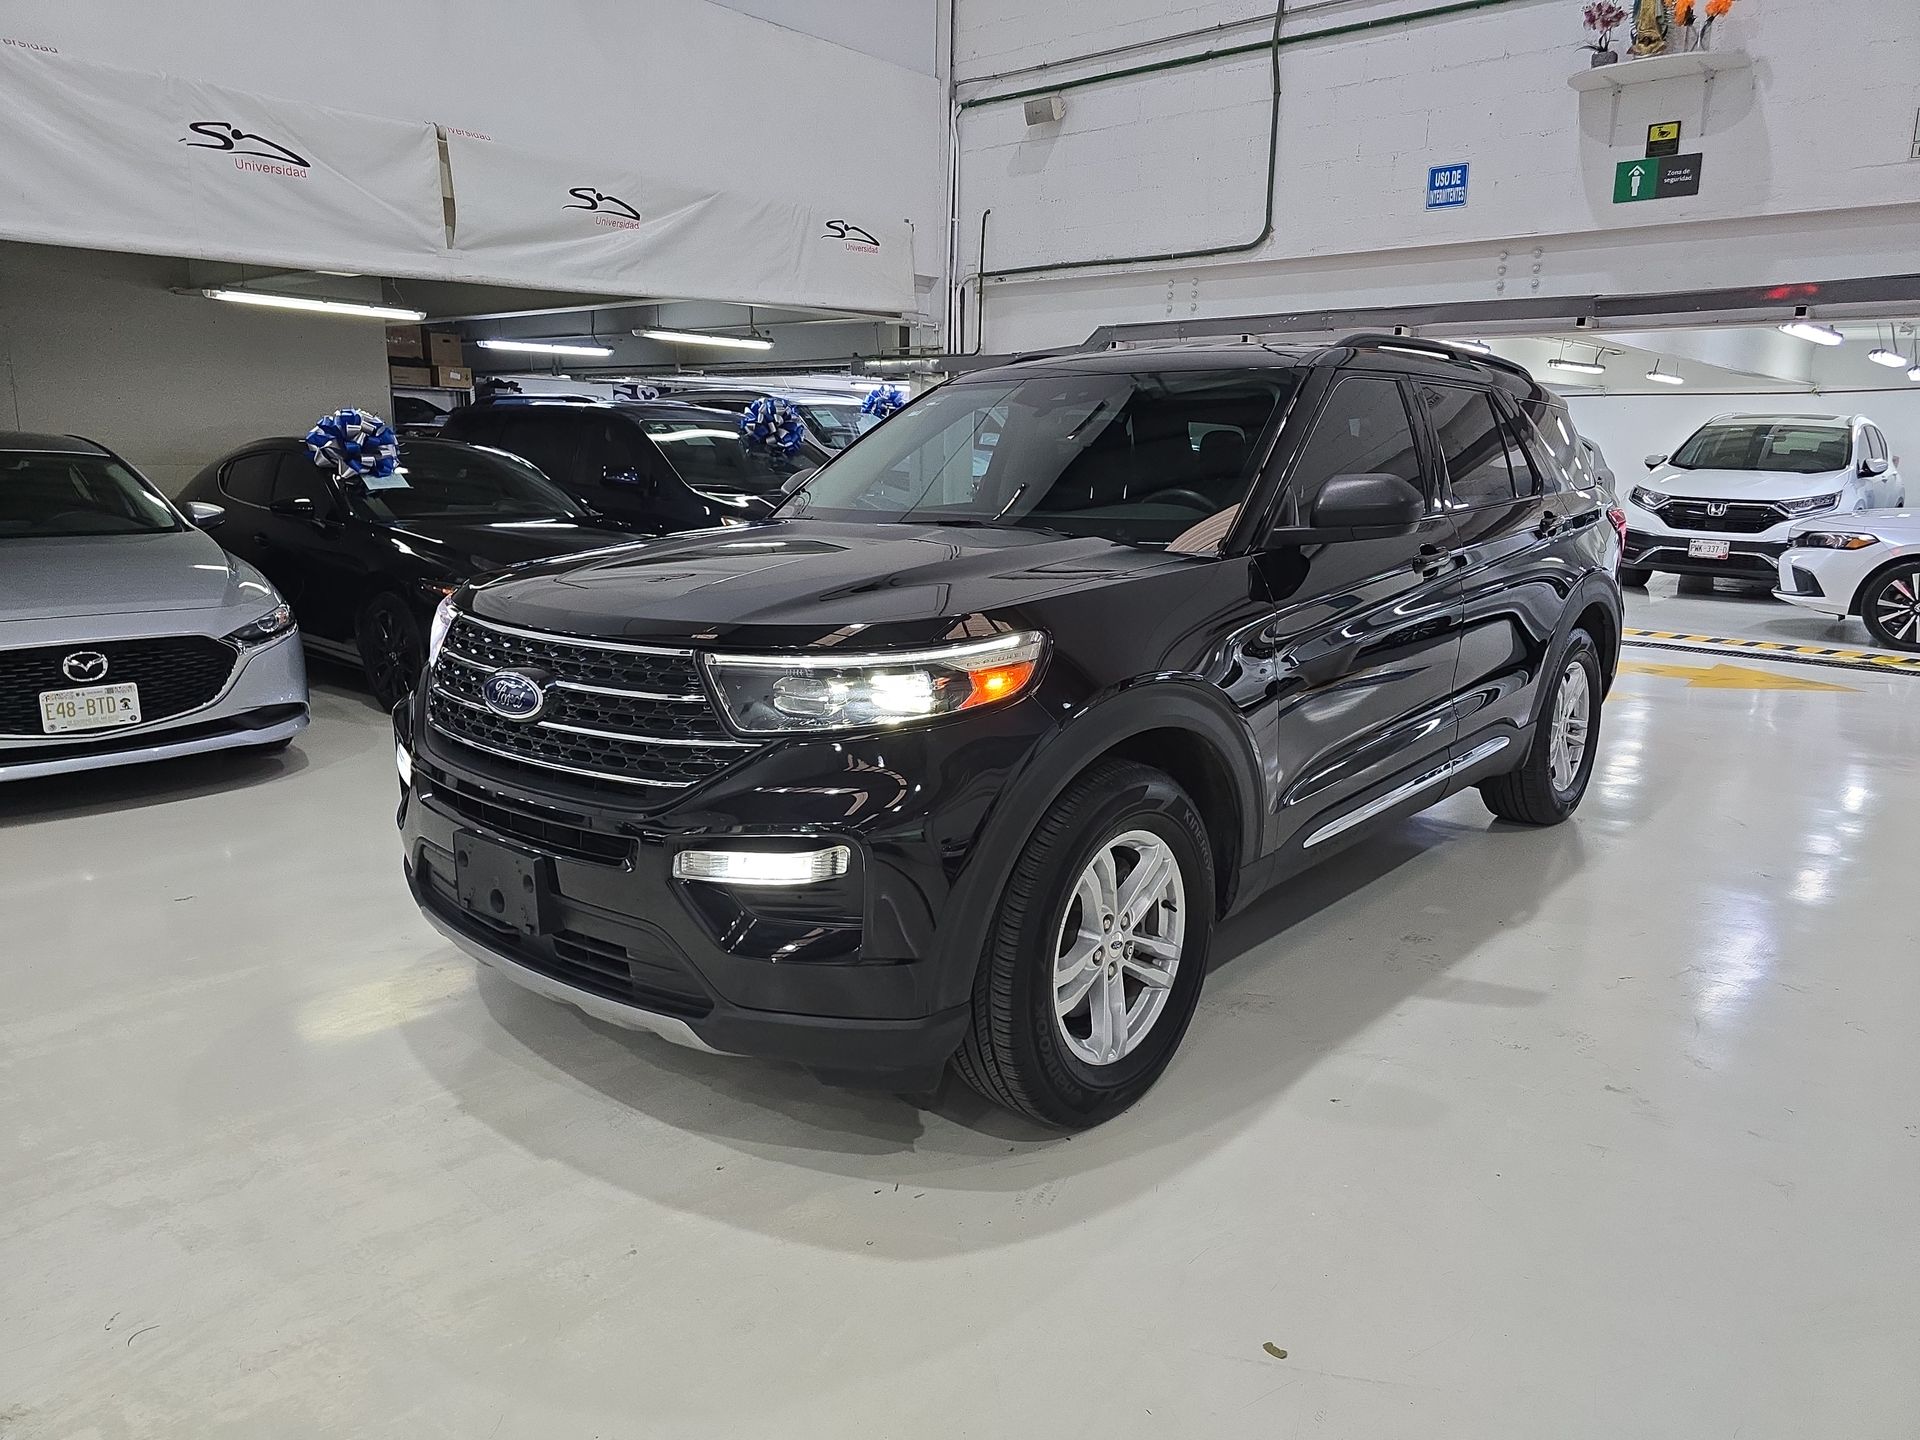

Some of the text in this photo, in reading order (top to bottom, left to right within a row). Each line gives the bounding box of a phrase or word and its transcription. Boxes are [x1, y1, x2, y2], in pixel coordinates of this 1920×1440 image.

[234, 158, 308, 179] Universidad
[1667, 167, 1691, 177] Zona de
[1434, 169, 1462, 188] USO DE
[1663, 174, 1692, 184] seguridad
[595, 215, 640, 230] Universidad
[845, 242, 879, 254] Universidad
[491, 679, 526, 709] Ford
[44, 696, 117, 721] E48-BTD
